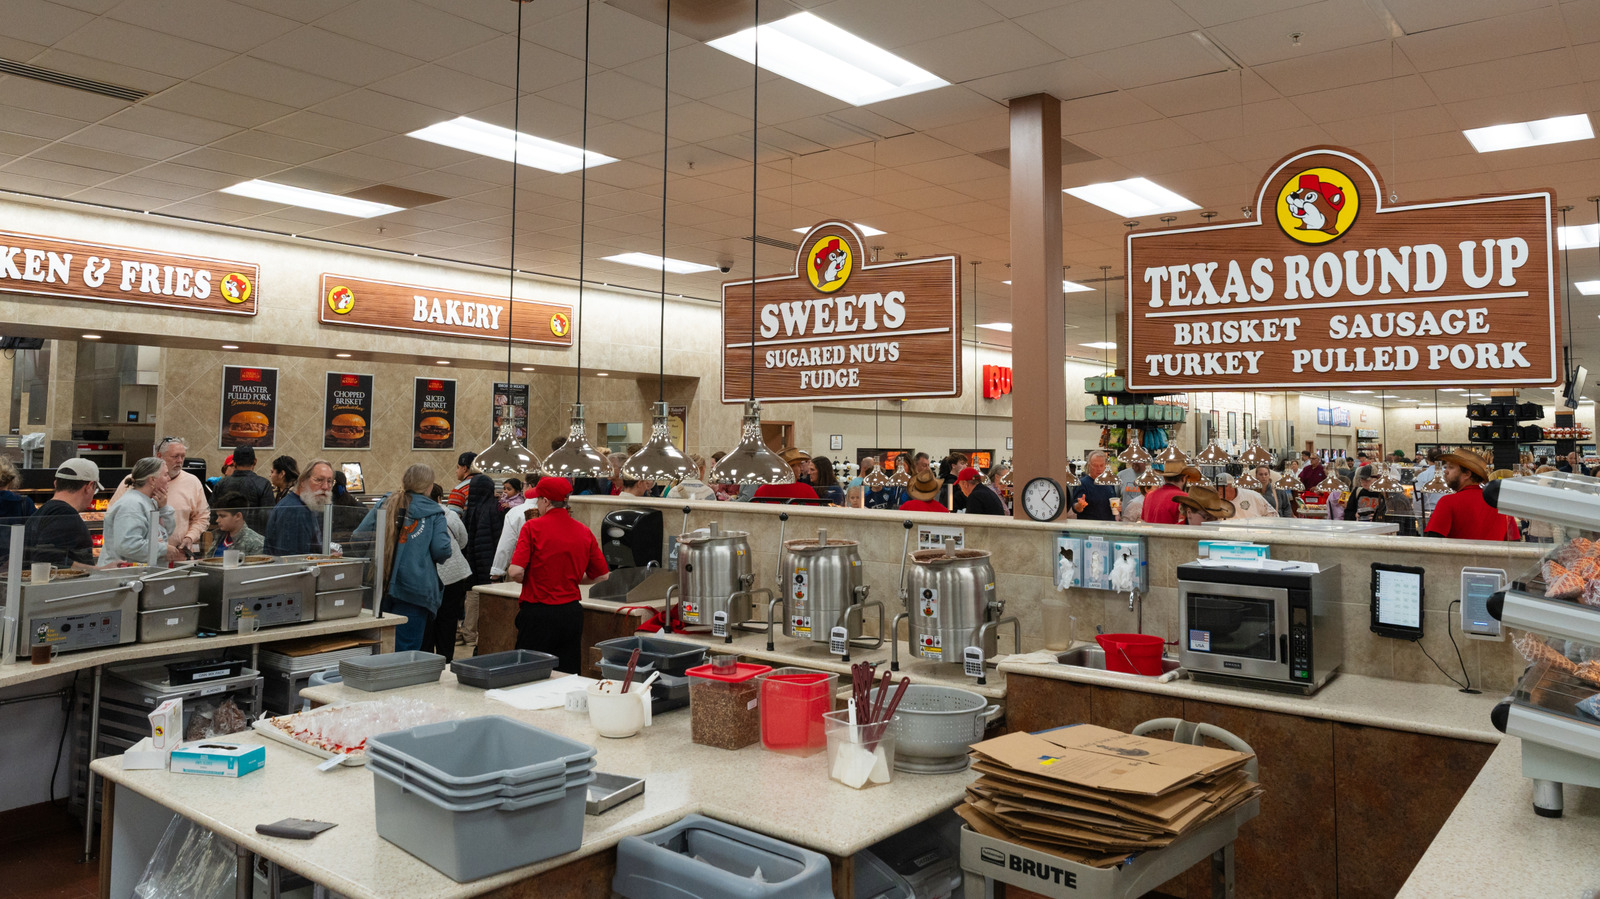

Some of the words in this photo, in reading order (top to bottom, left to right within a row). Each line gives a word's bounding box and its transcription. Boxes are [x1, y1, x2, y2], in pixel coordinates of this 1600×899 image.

[83, 256, 111, 288] &
[119, 259, 212, 299] FRIES
[1144, 257, 1275, 308] TEXAS
[1283, 243, 1448, 300] ROUND
[1458, 236, 1530, 289] UP
[412, 295, 503, 330] BAKERY
[759, 291, 906, 339] SWEETS
[1173, 317, 1301, 346] BRISKET
[1328, 307, 1490, 340] SAUSAGE
[765, 344, 846, 369] SUGARED
[849, 341, 900, 364] NUTS
[1145, 350, 1264, 377] TURKEY
[1291, 345, 1420, 374] PULLED
[1426, 341, 1531, 370] PORK
[232, 384, 268, 394] PITMASTER
[800, 367, 860, 390] FUDGE
[983, 364, 1012, 400] BU
[227, 392, 251, 400] PULLED
[252, 393, 272, 401] PORK
[333, 390, 366, 399] CHOPPED
[335, 397, 363, 406] BRISKET
[423, 401, 447, 410] BRISKET
[425, 394, 446, 403] SLICED
[1009, 853, 1077, 889] BRUTE
